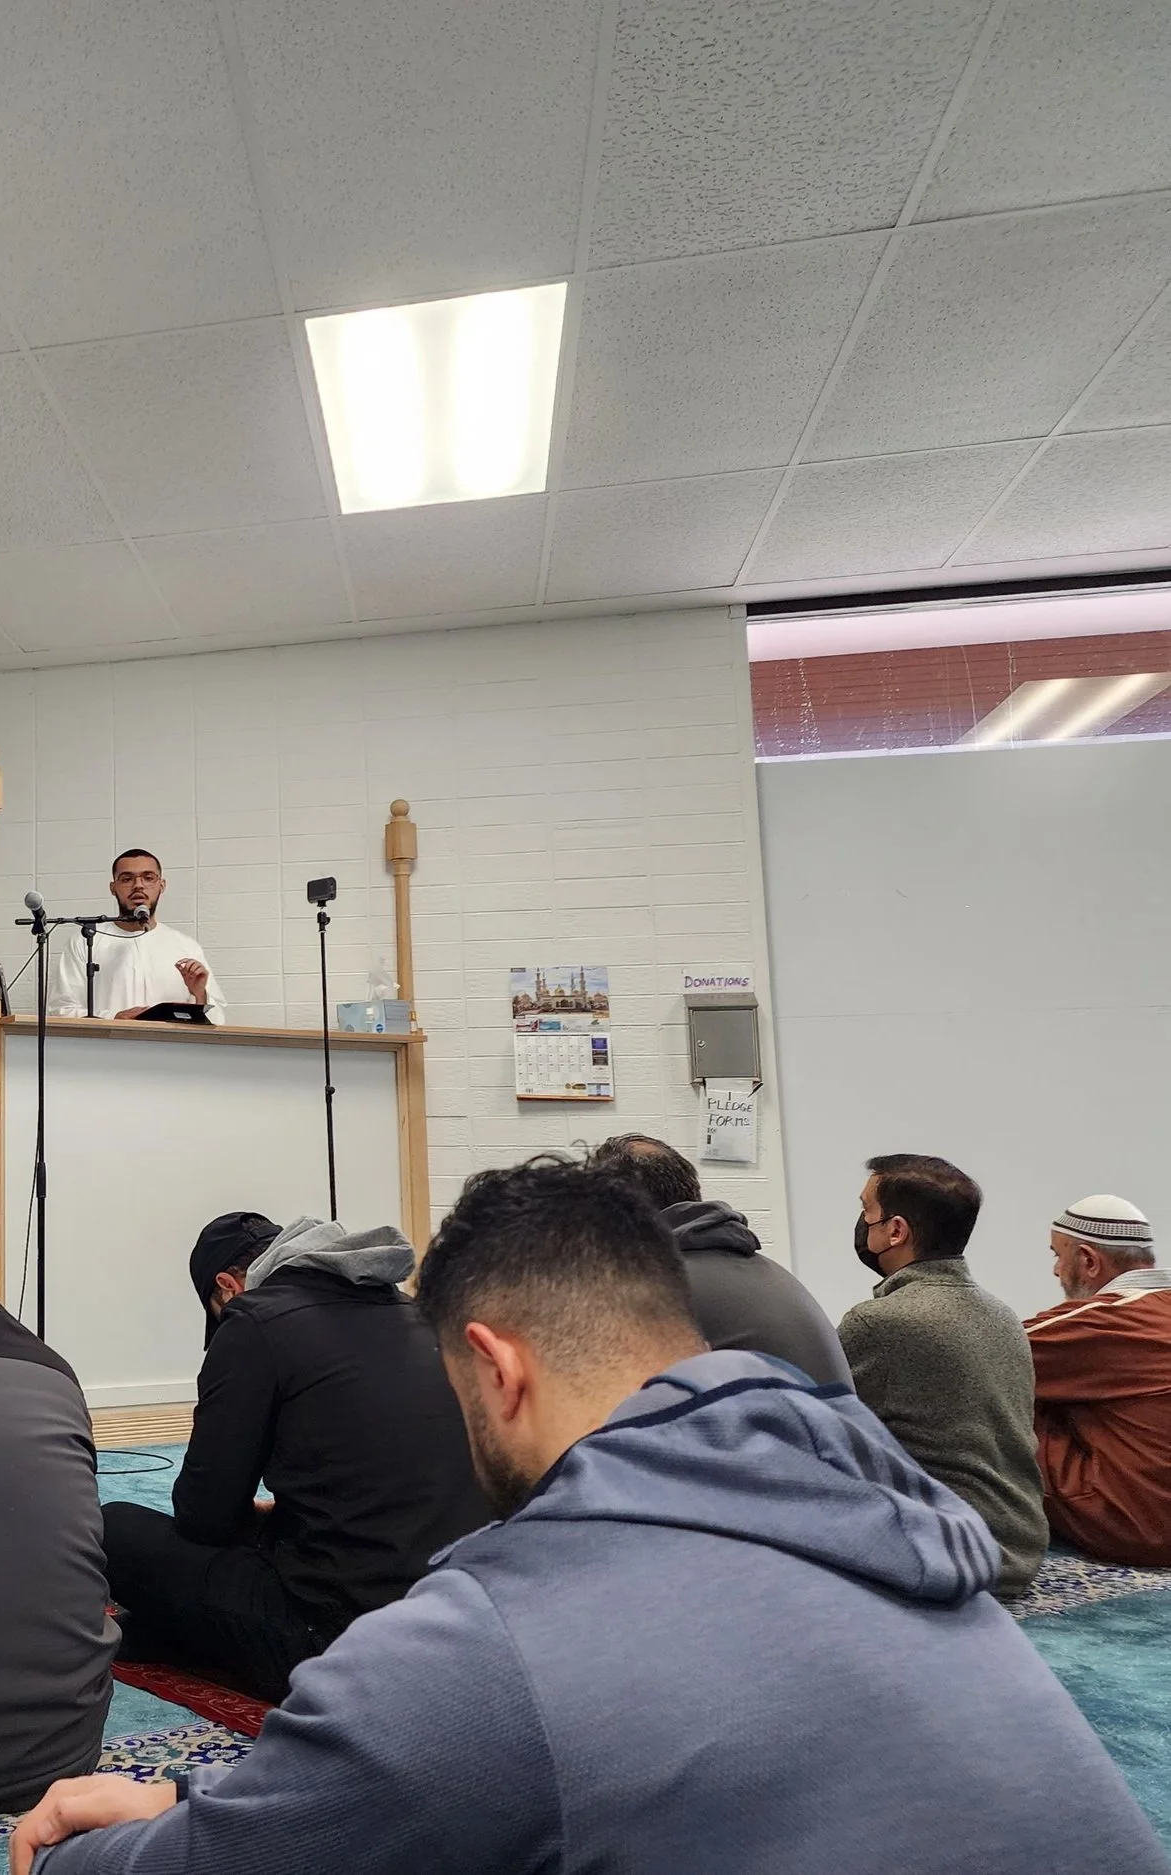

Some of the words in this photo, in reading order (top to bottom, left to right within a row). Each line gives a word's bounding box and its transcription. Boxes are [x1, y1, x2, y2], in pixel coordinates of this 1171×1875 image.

[684, 975, 750, 989] DONATIONS
[707, 1097, 754, 1113] PLEDGE
[707, 1112, 751, 1127] FORMS
